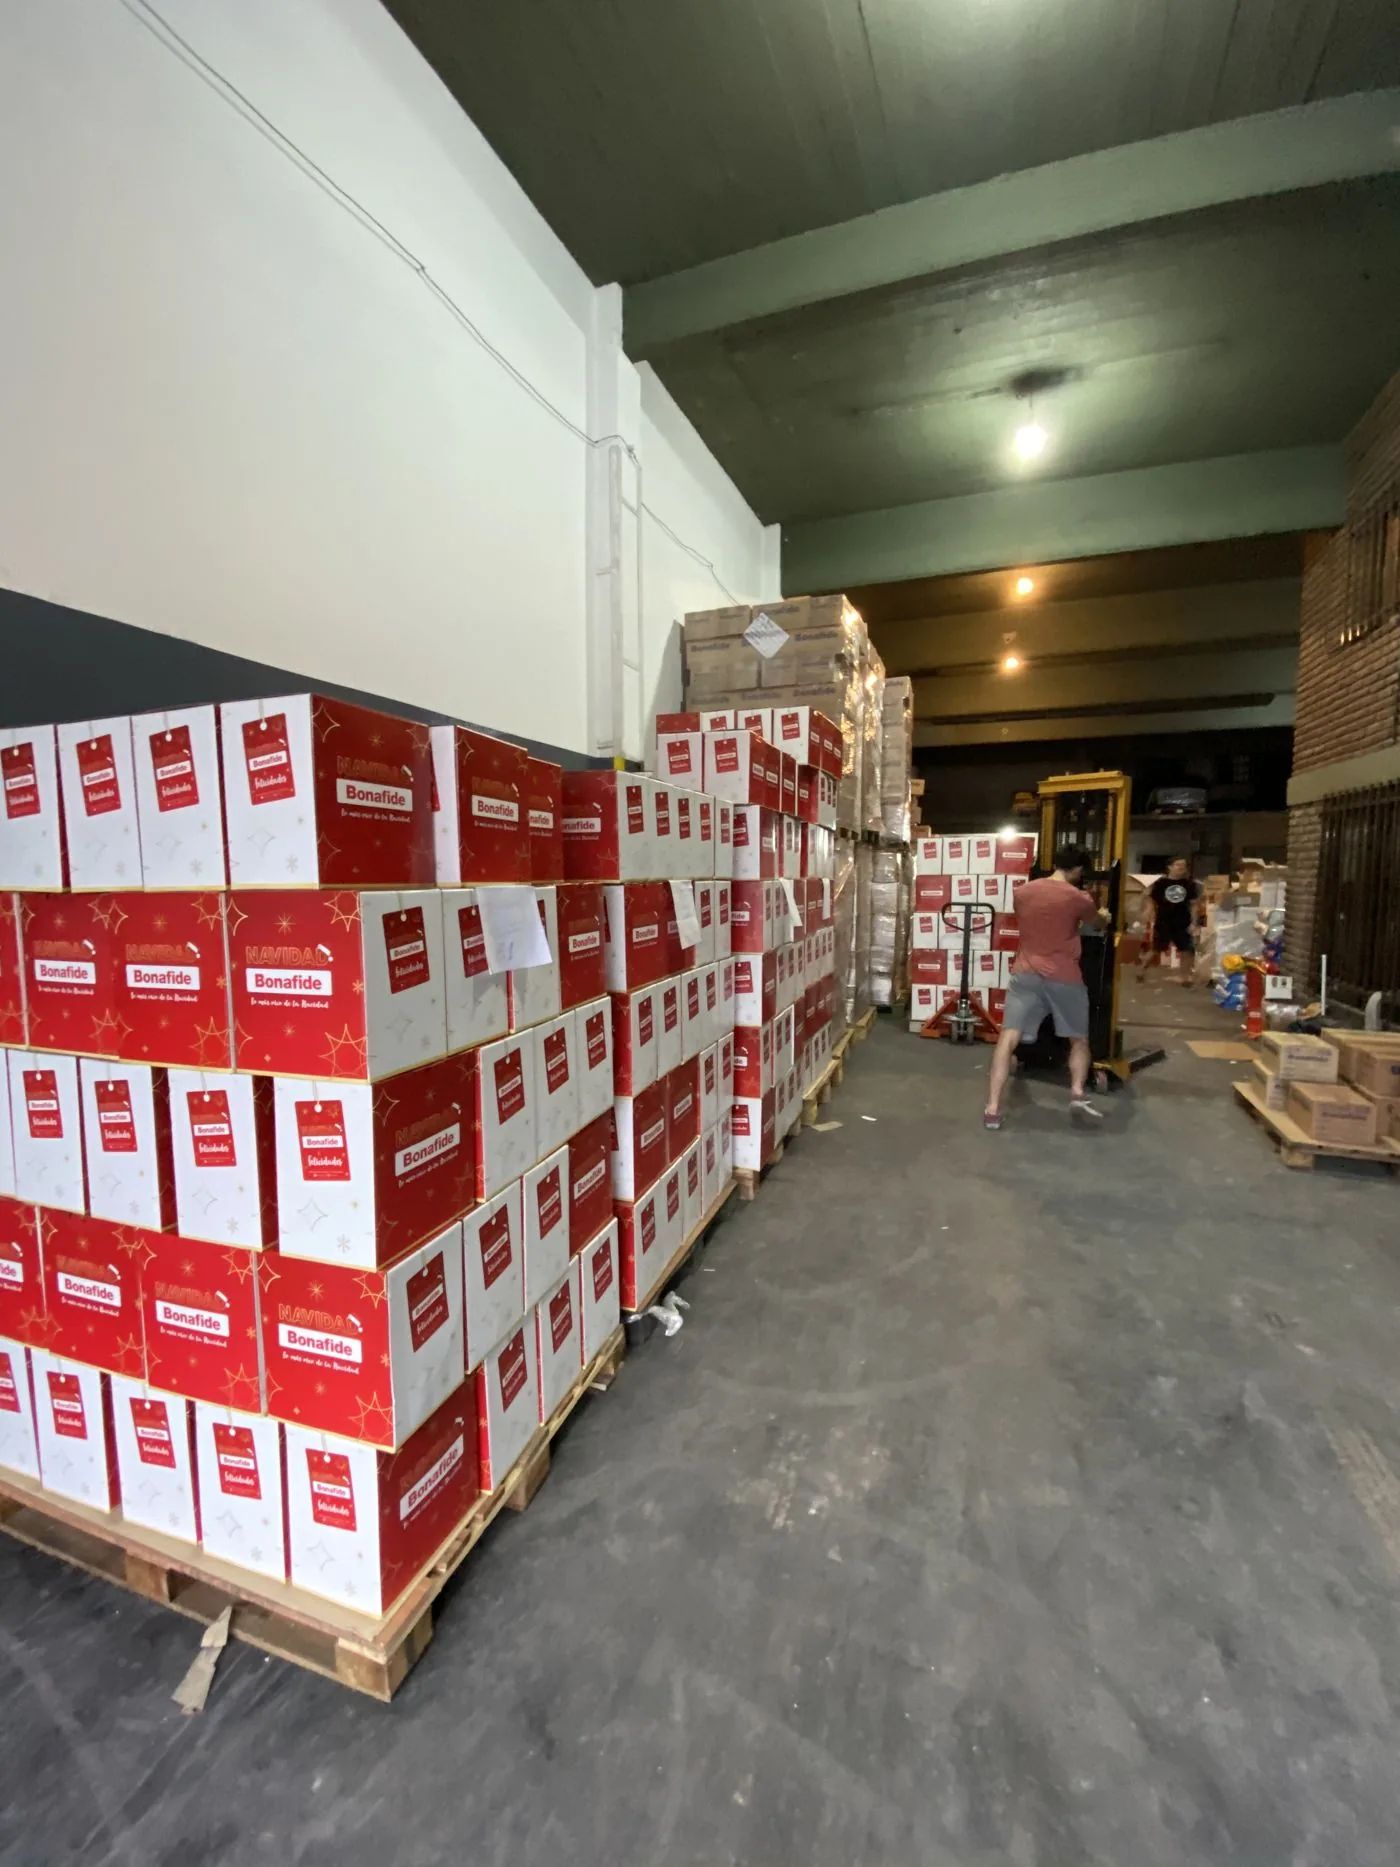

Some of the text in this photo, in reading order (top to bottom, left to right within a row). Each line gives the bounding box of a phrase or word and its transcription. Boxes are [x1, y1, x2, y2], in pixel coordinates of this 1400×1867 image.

[346, 784, 406, 806] Bonafide
[477, 800, 514, 818] Bonafide
[40, 964, 89, 980] Bonafide
[133, 969, 192, 985] Bonafide
[254, 973, 322, 991] Bonafide
[403, 1132, 454, 1168] Bonafide
[64, 1278, 114, 1301] Bonafide
[163, 1306, 221, 1330] Bonafide
[287, 1329, 353, 1356] Bonafide
[408, 1447, 459, 1508] Bonafide
